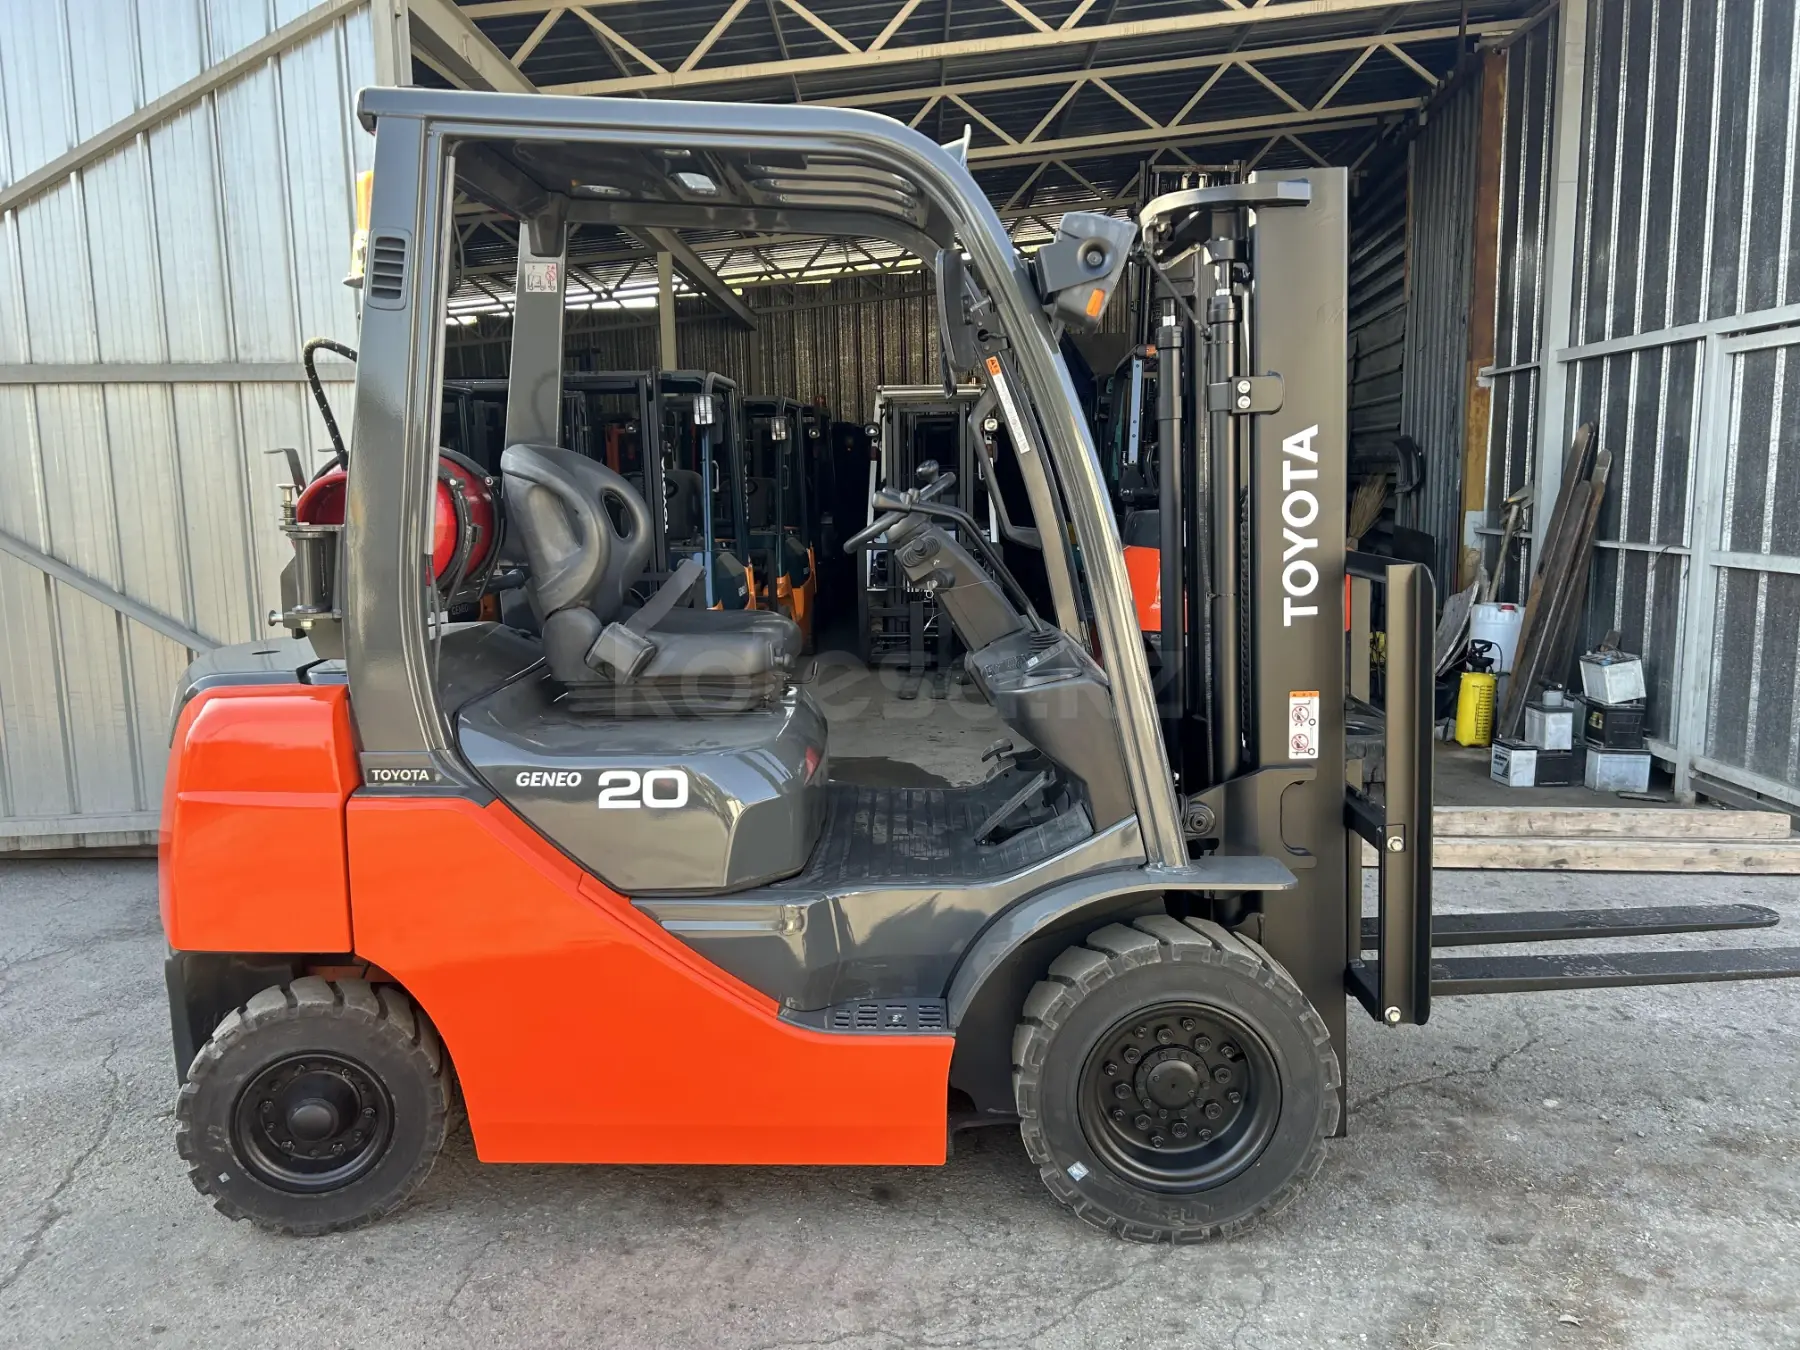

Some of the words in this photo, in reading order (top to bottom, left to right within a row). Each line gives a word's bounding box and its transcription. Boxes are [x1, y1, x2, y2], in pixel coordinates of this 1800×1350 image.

[1281, 424, 1319, 627] TOYOTA
[371, 769, 430, 781] TOYOTA
[515, 771, 582, 787] GENEO
[598, 769, 689, 809] 20
